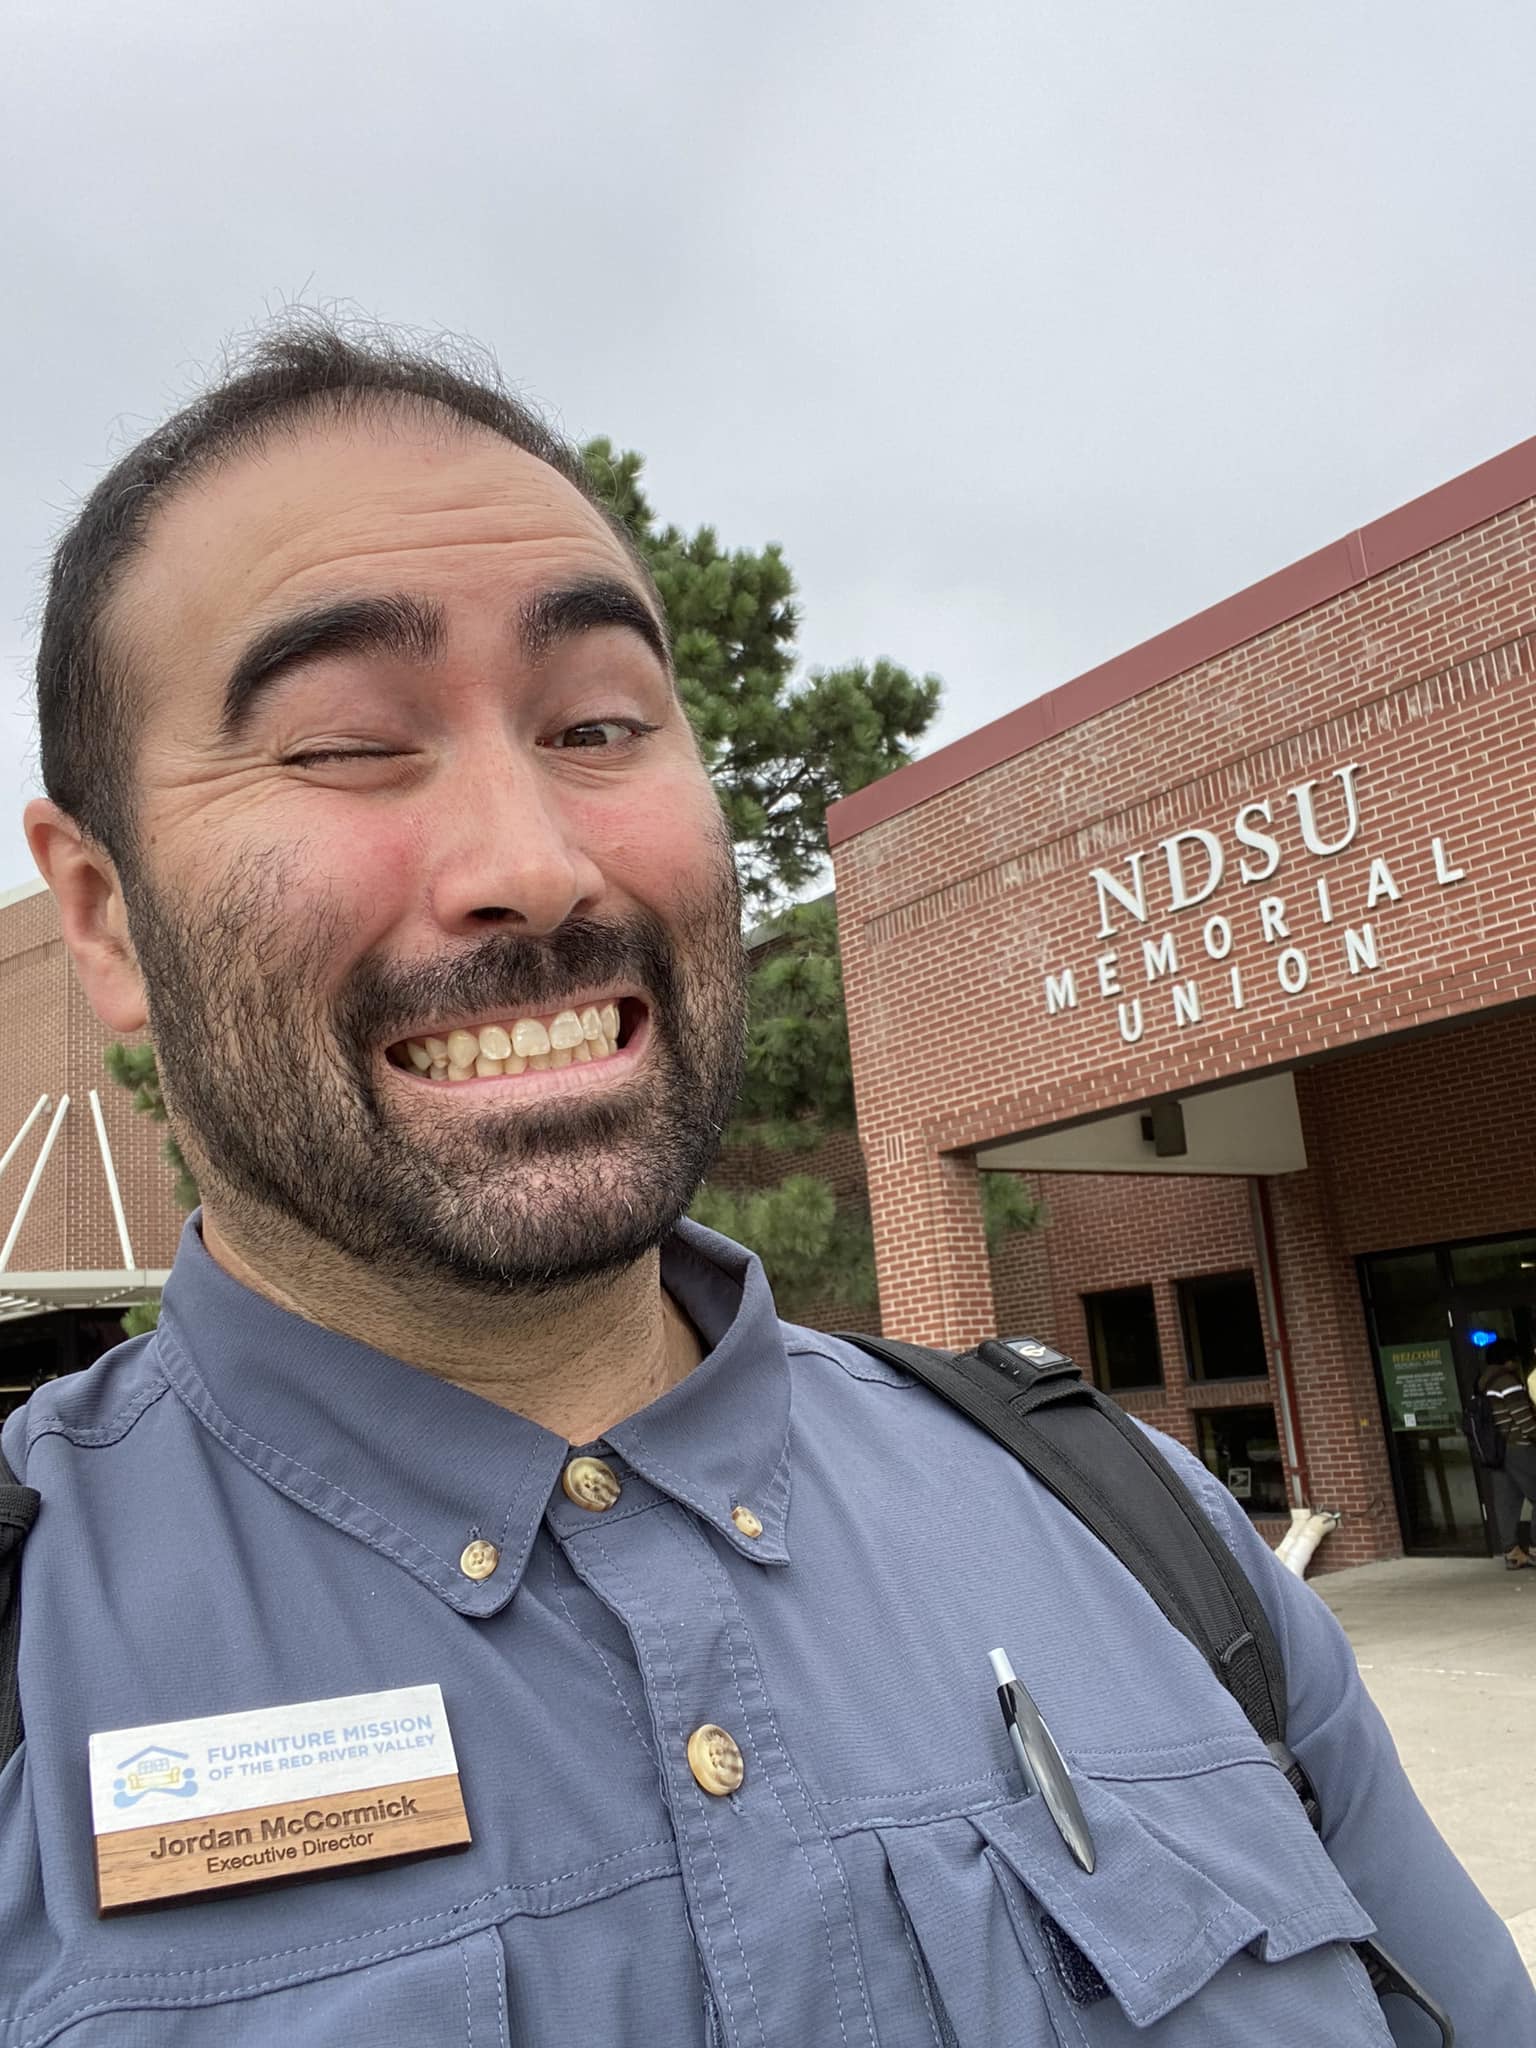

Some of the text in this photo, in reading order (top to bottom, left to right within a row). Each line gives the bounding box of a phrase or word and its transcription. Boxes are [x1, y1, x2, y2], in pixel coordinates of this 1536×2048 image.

[1089, 763, 1361, 939] NDSU
[1045, 837, 1466, 1015] MEMORIAL
[1118, 923, 1380, 1042] UNION
[1392, 1349, 1441, 1363] WELCOME
[207, 1714, 433, 1764] FURNITURE MISSION
[208, 1733, 436, 1782] OF THE RED RIVER VALLEY
[150, 1795, 419, 1860] Jordan McCormick
[207, 1832, 374, 1875] Executive Director
